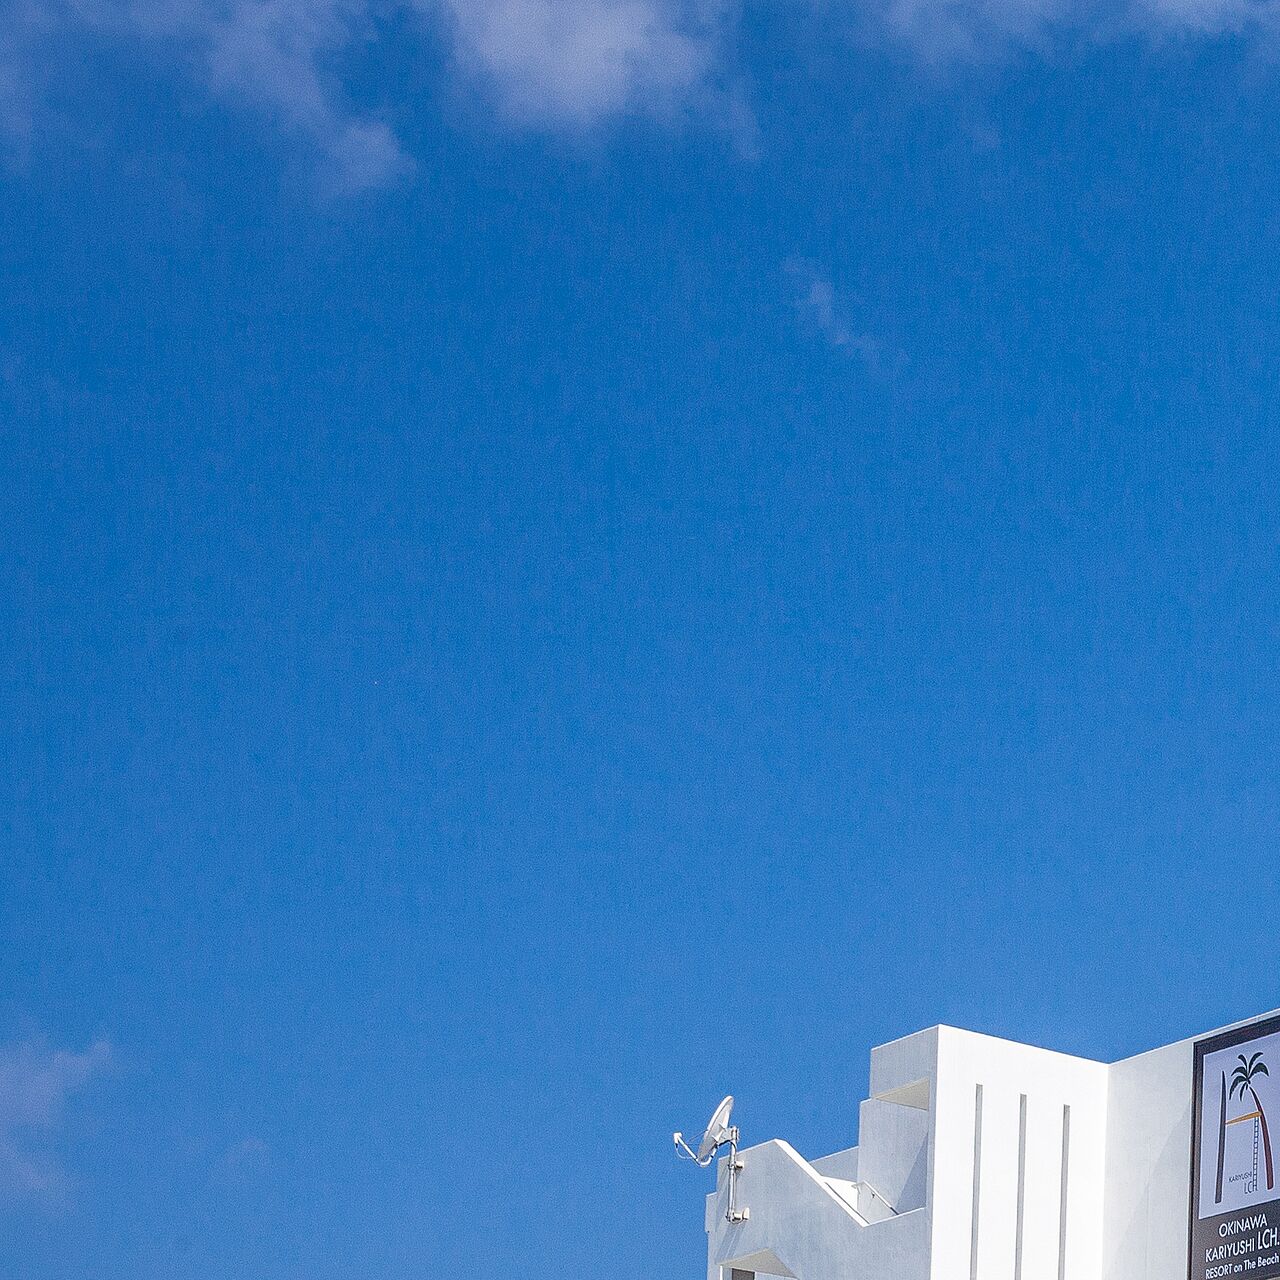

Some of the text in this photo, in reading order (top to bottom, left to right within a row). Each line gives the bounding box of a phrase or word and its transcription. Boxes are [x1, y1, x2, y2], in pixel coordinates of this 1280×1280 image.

[1219, 1213, 1268, 1237] OKINAWA
[1205, 1227, 1280, 1263] KARIYUSHI LCH.
[1205, 1252, 1279, 1280] RESORT on The Beach
